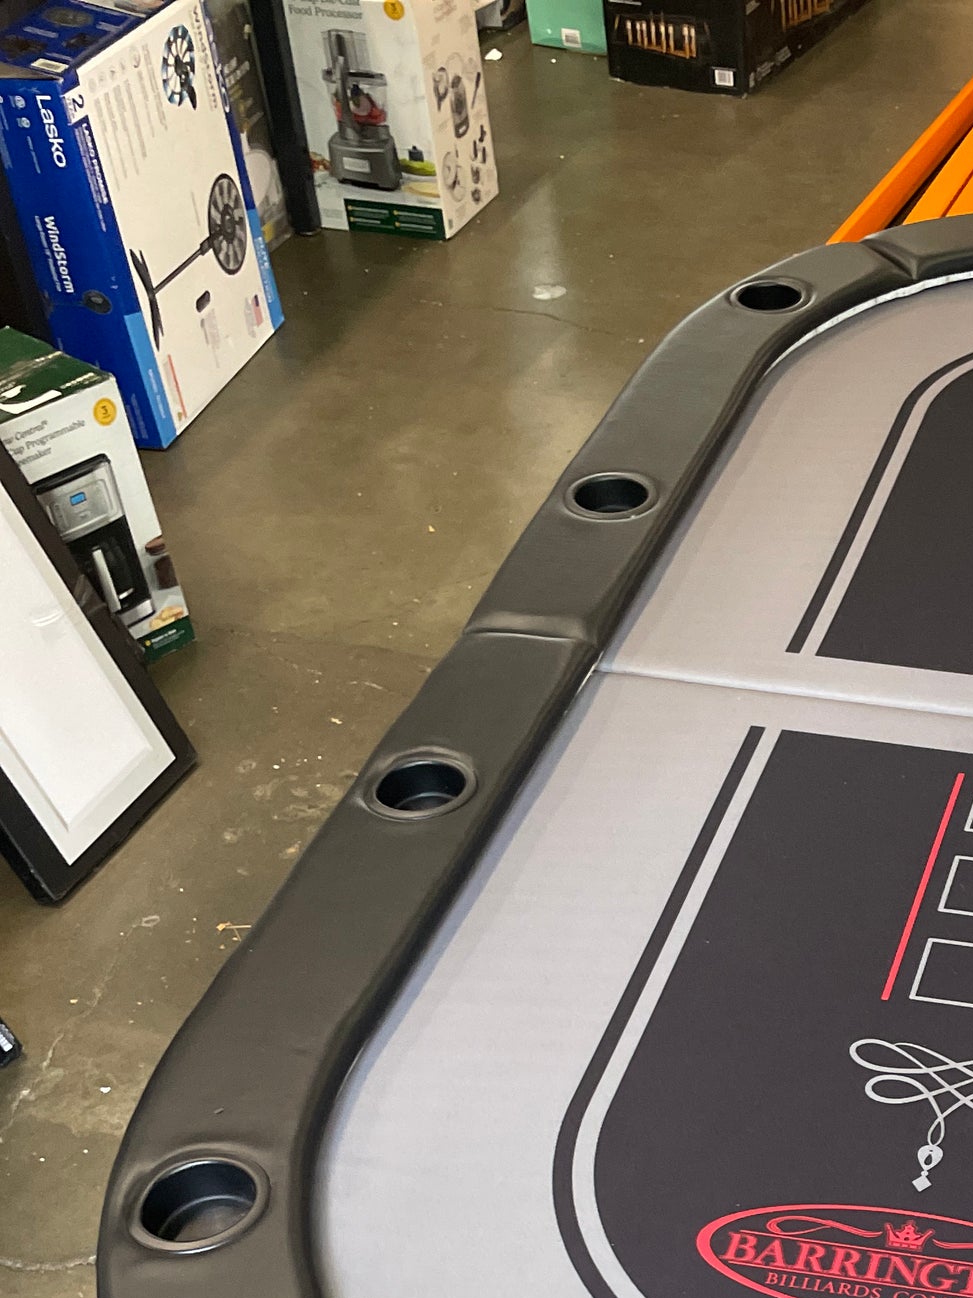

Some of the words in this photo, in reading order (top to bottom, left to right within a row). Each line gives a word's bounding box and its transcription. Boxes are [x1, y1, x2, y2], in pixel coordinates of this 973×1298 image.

[287, 4, 312, 17] Food
[315, 6, 363, 20] Processor
[72, 94, 85, 113] 2
[35, 94, 68, 168] Lasko
[44, 215, 75, 293] WindStorm
